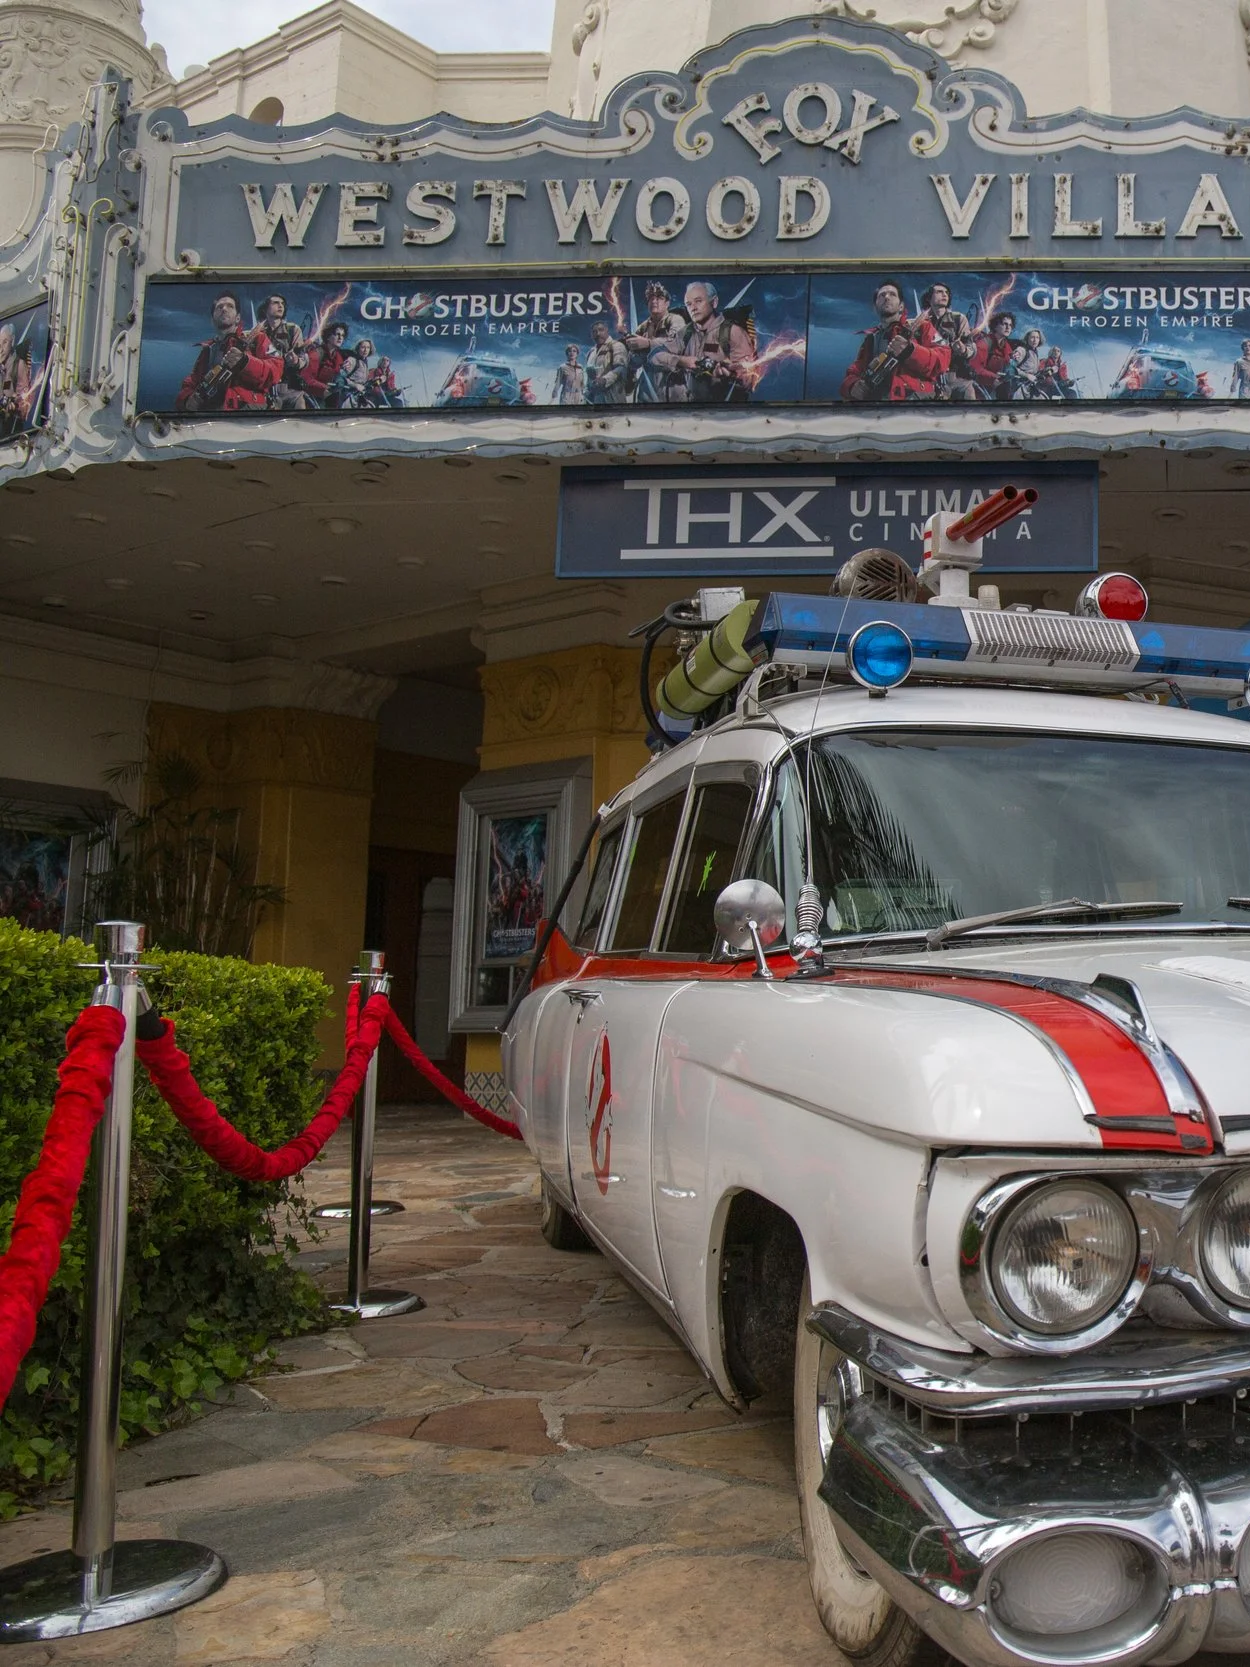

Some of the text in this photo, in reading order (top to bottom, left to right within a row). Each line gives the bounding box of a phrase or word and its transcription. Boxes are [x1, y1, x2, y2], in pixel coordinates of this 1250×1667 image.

[721, 82, 900, 165] FOX
[239, 175, 832, 248] WESTWOOD
[400, 321, 561, 337] FROZEN EMPIRE
[1069, 315, 1234, 328] FROZEN EMPIRE
[850, 488, 1033, 517] ULTIMA
[849, 521, 1032, 542] CINA
